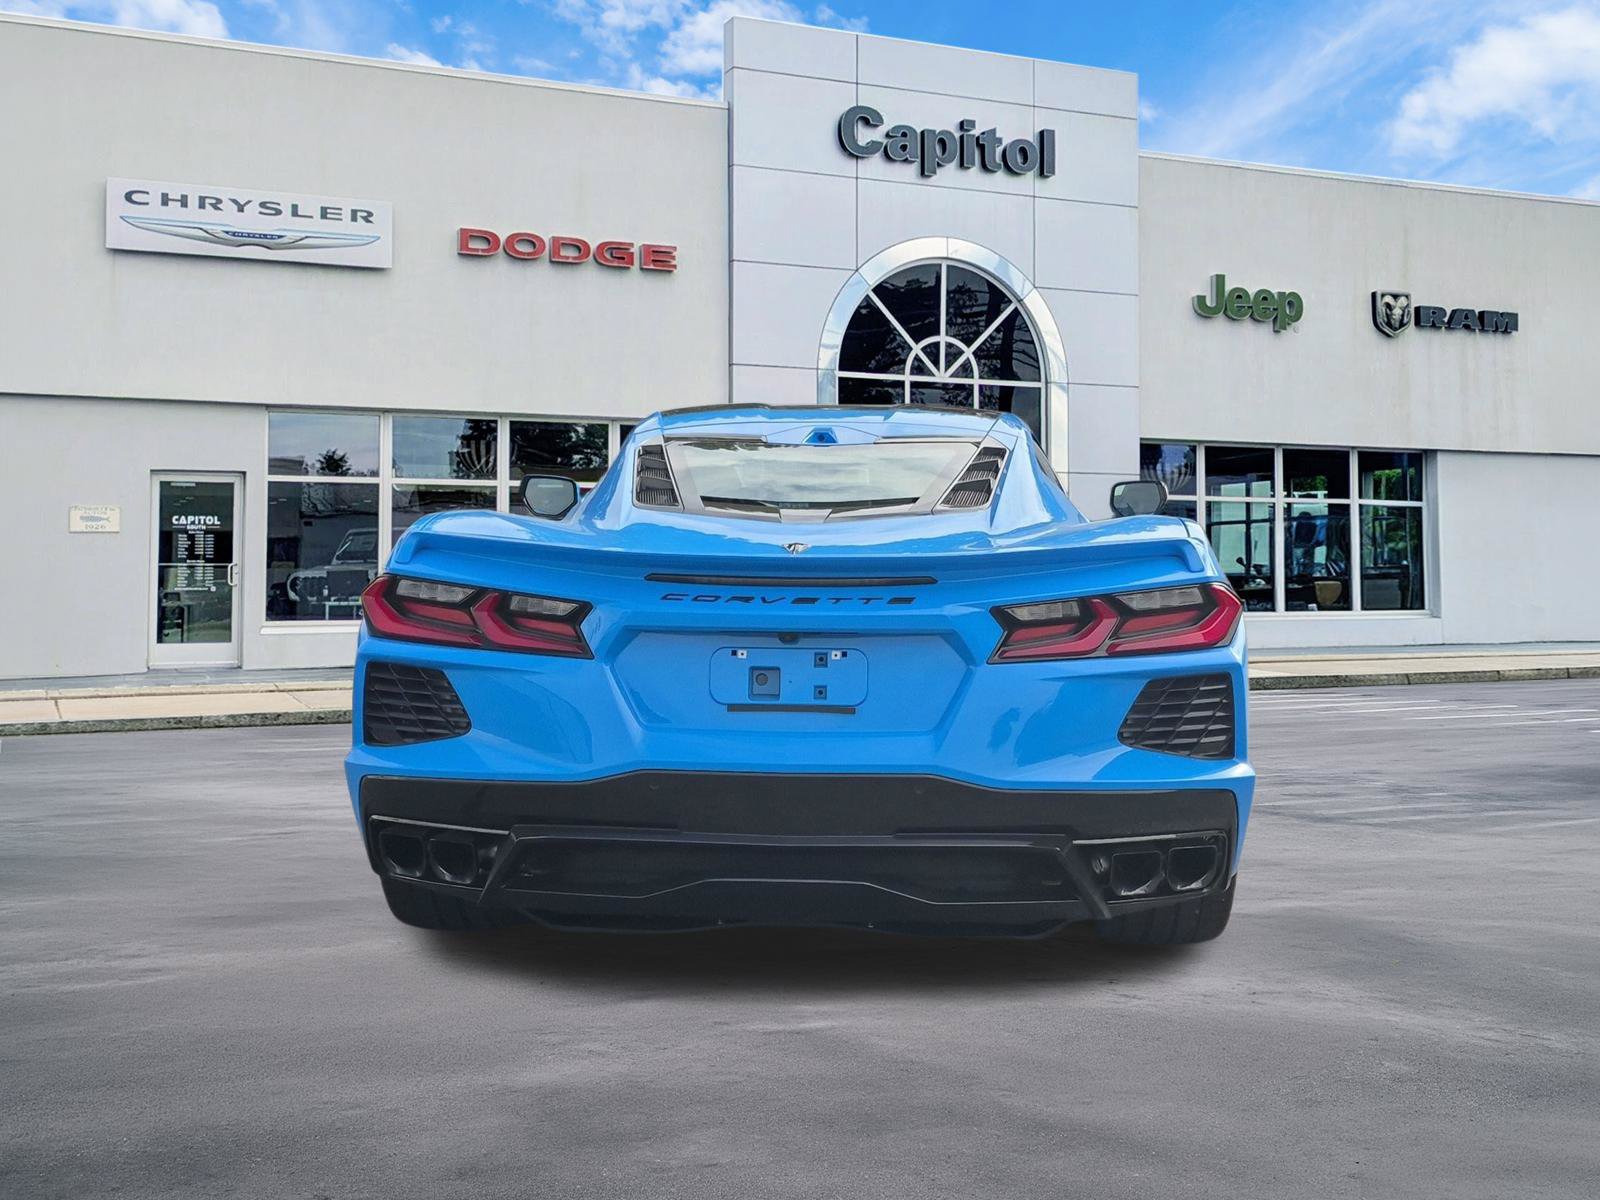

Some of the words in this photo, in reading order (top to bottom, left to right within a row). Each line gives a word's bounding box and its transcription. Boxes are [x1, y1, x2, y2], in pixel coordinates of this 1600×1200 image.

[838, 105, 1056, 178] Capitol
[123, 189, 376, 225] CHRYSLER
[457, 227, 678, 272] DODGE
[1192, 273, 1304, 333] Jeep
[1414, 304, 1519, 334] RAM
[172, 515, 221, 525] CAPITOL
[660, 593, 917, 605] CORVETTE
